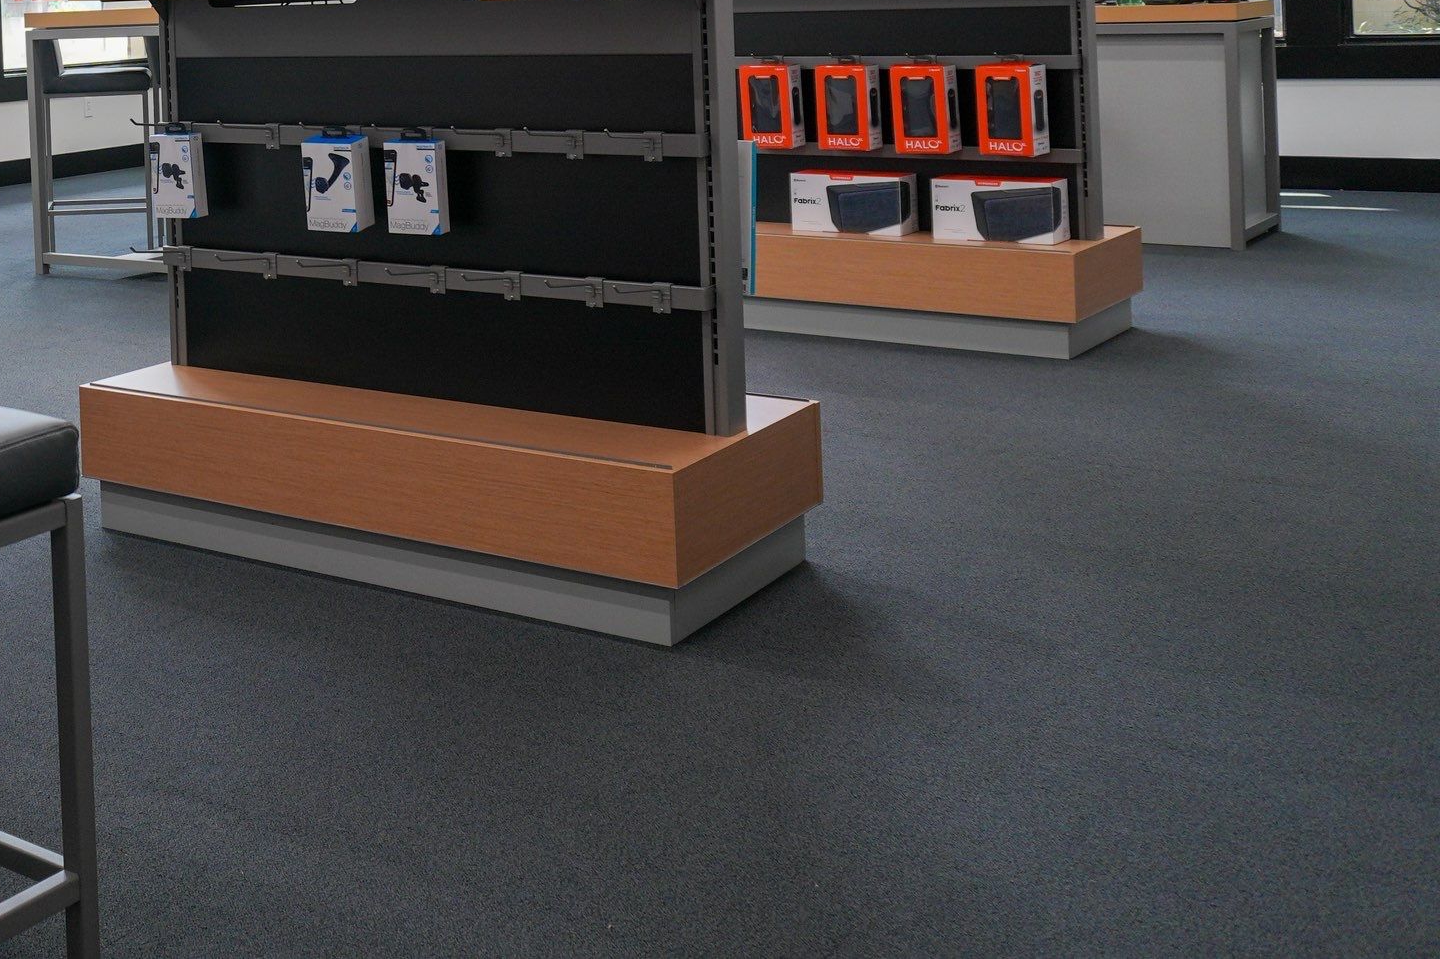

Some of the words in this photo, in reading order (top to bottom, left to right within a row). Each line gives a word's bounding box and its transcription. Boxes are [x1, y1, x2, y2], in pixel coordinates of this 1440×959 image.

[753, 135, 783, 145] HALO
[828, 137, 860, 146] HALO
[905, 140, 939, 149] HALO
[989, 142, 1023, 152] HALO
[310, 219, 348, 229] MagBuddy
[389, 220, 429, 231] MagBuddy
